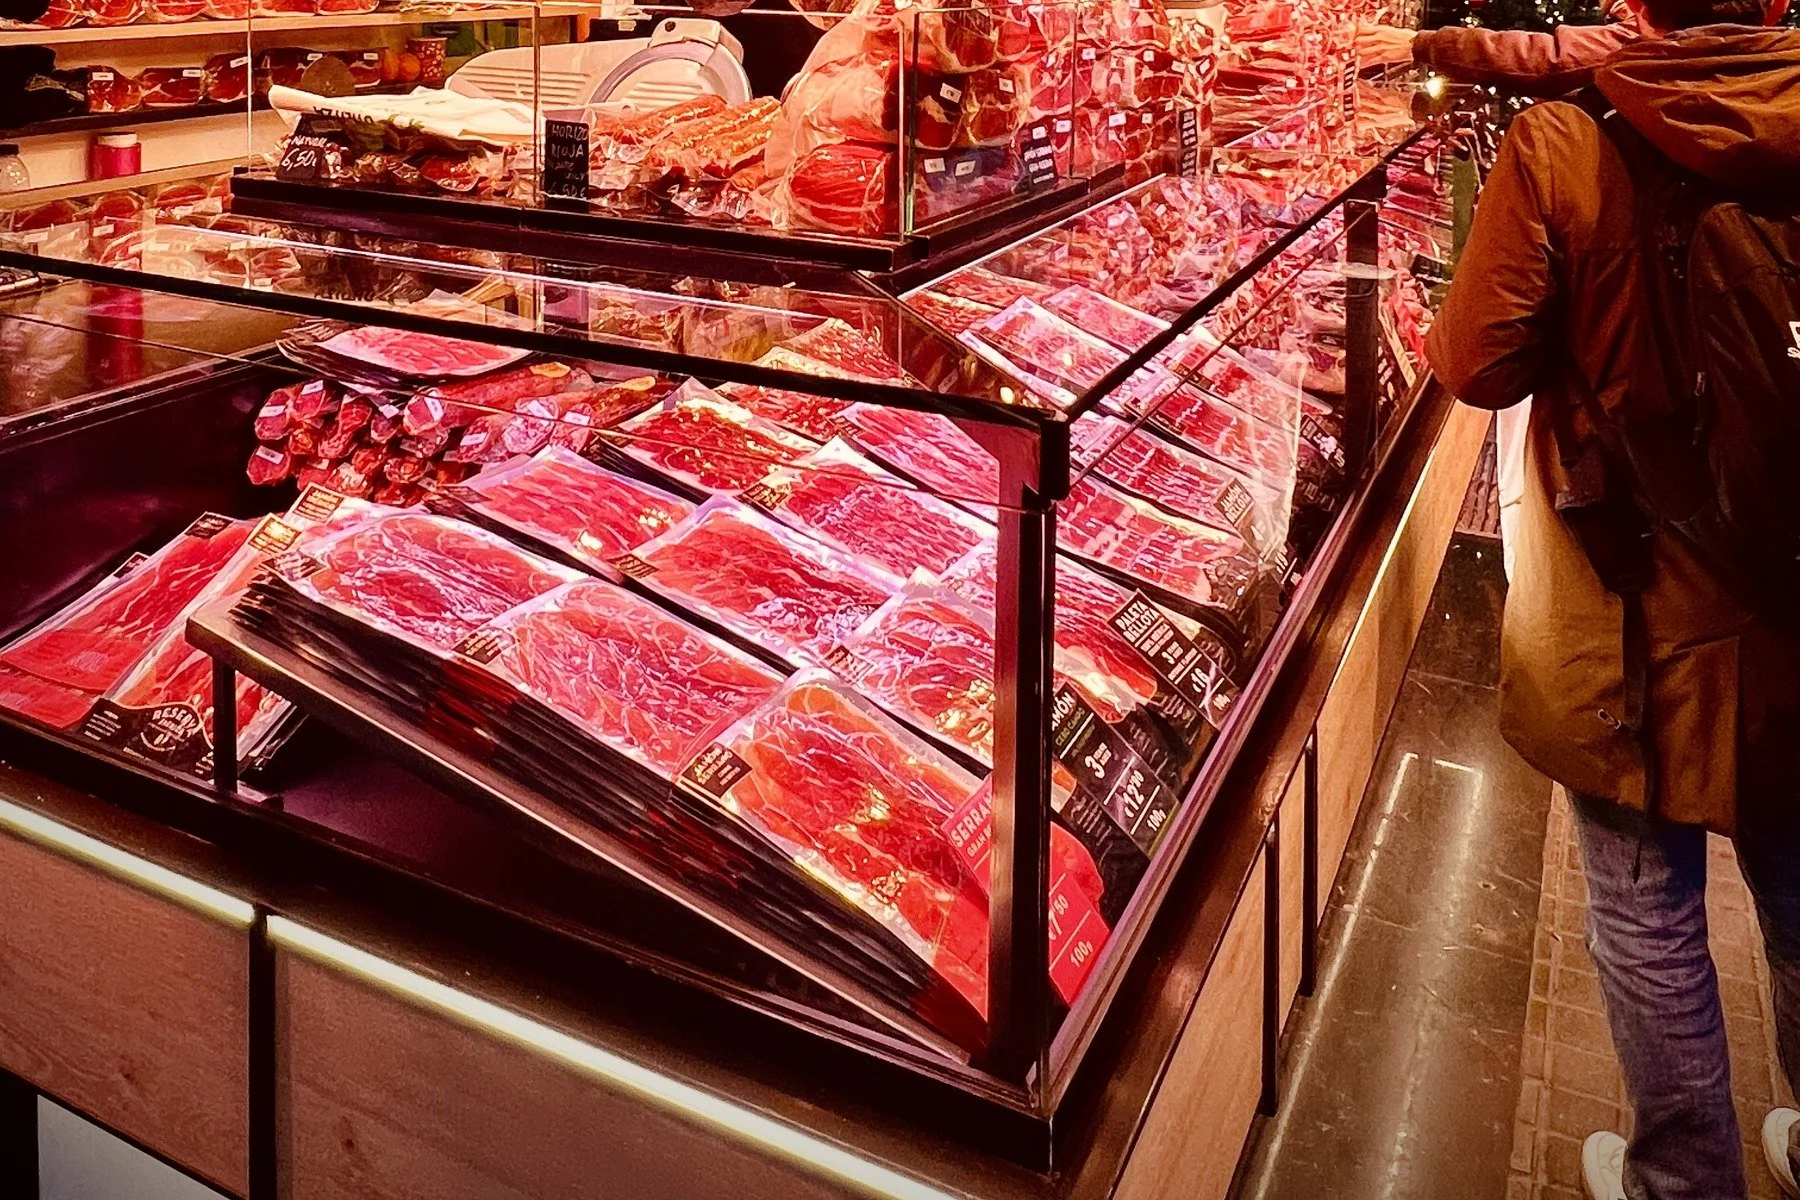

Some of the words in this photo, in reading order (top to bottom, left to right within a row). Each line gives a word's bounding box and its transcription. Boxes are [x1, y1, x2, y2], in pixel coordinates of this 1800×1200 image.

[551, 143, 585, 158] RIOJA
[1114, 600, 1149, 630] PALETA
[1122, 608, 1160, 643] BELLOTA
[1162, 652, 1174, 664] 3
[1052, 692, 1076, 731] AMÓN
[1056, 728, 1070, 746] CEBO
[1085, 756, 1104, 778] 3
[949, 793, 993, 848] SERRAN
[1147, 810, 1166, 831] 100g
[967, 834, 986, 857] GRAN
[1069, 940, 1094, 968] 100g
